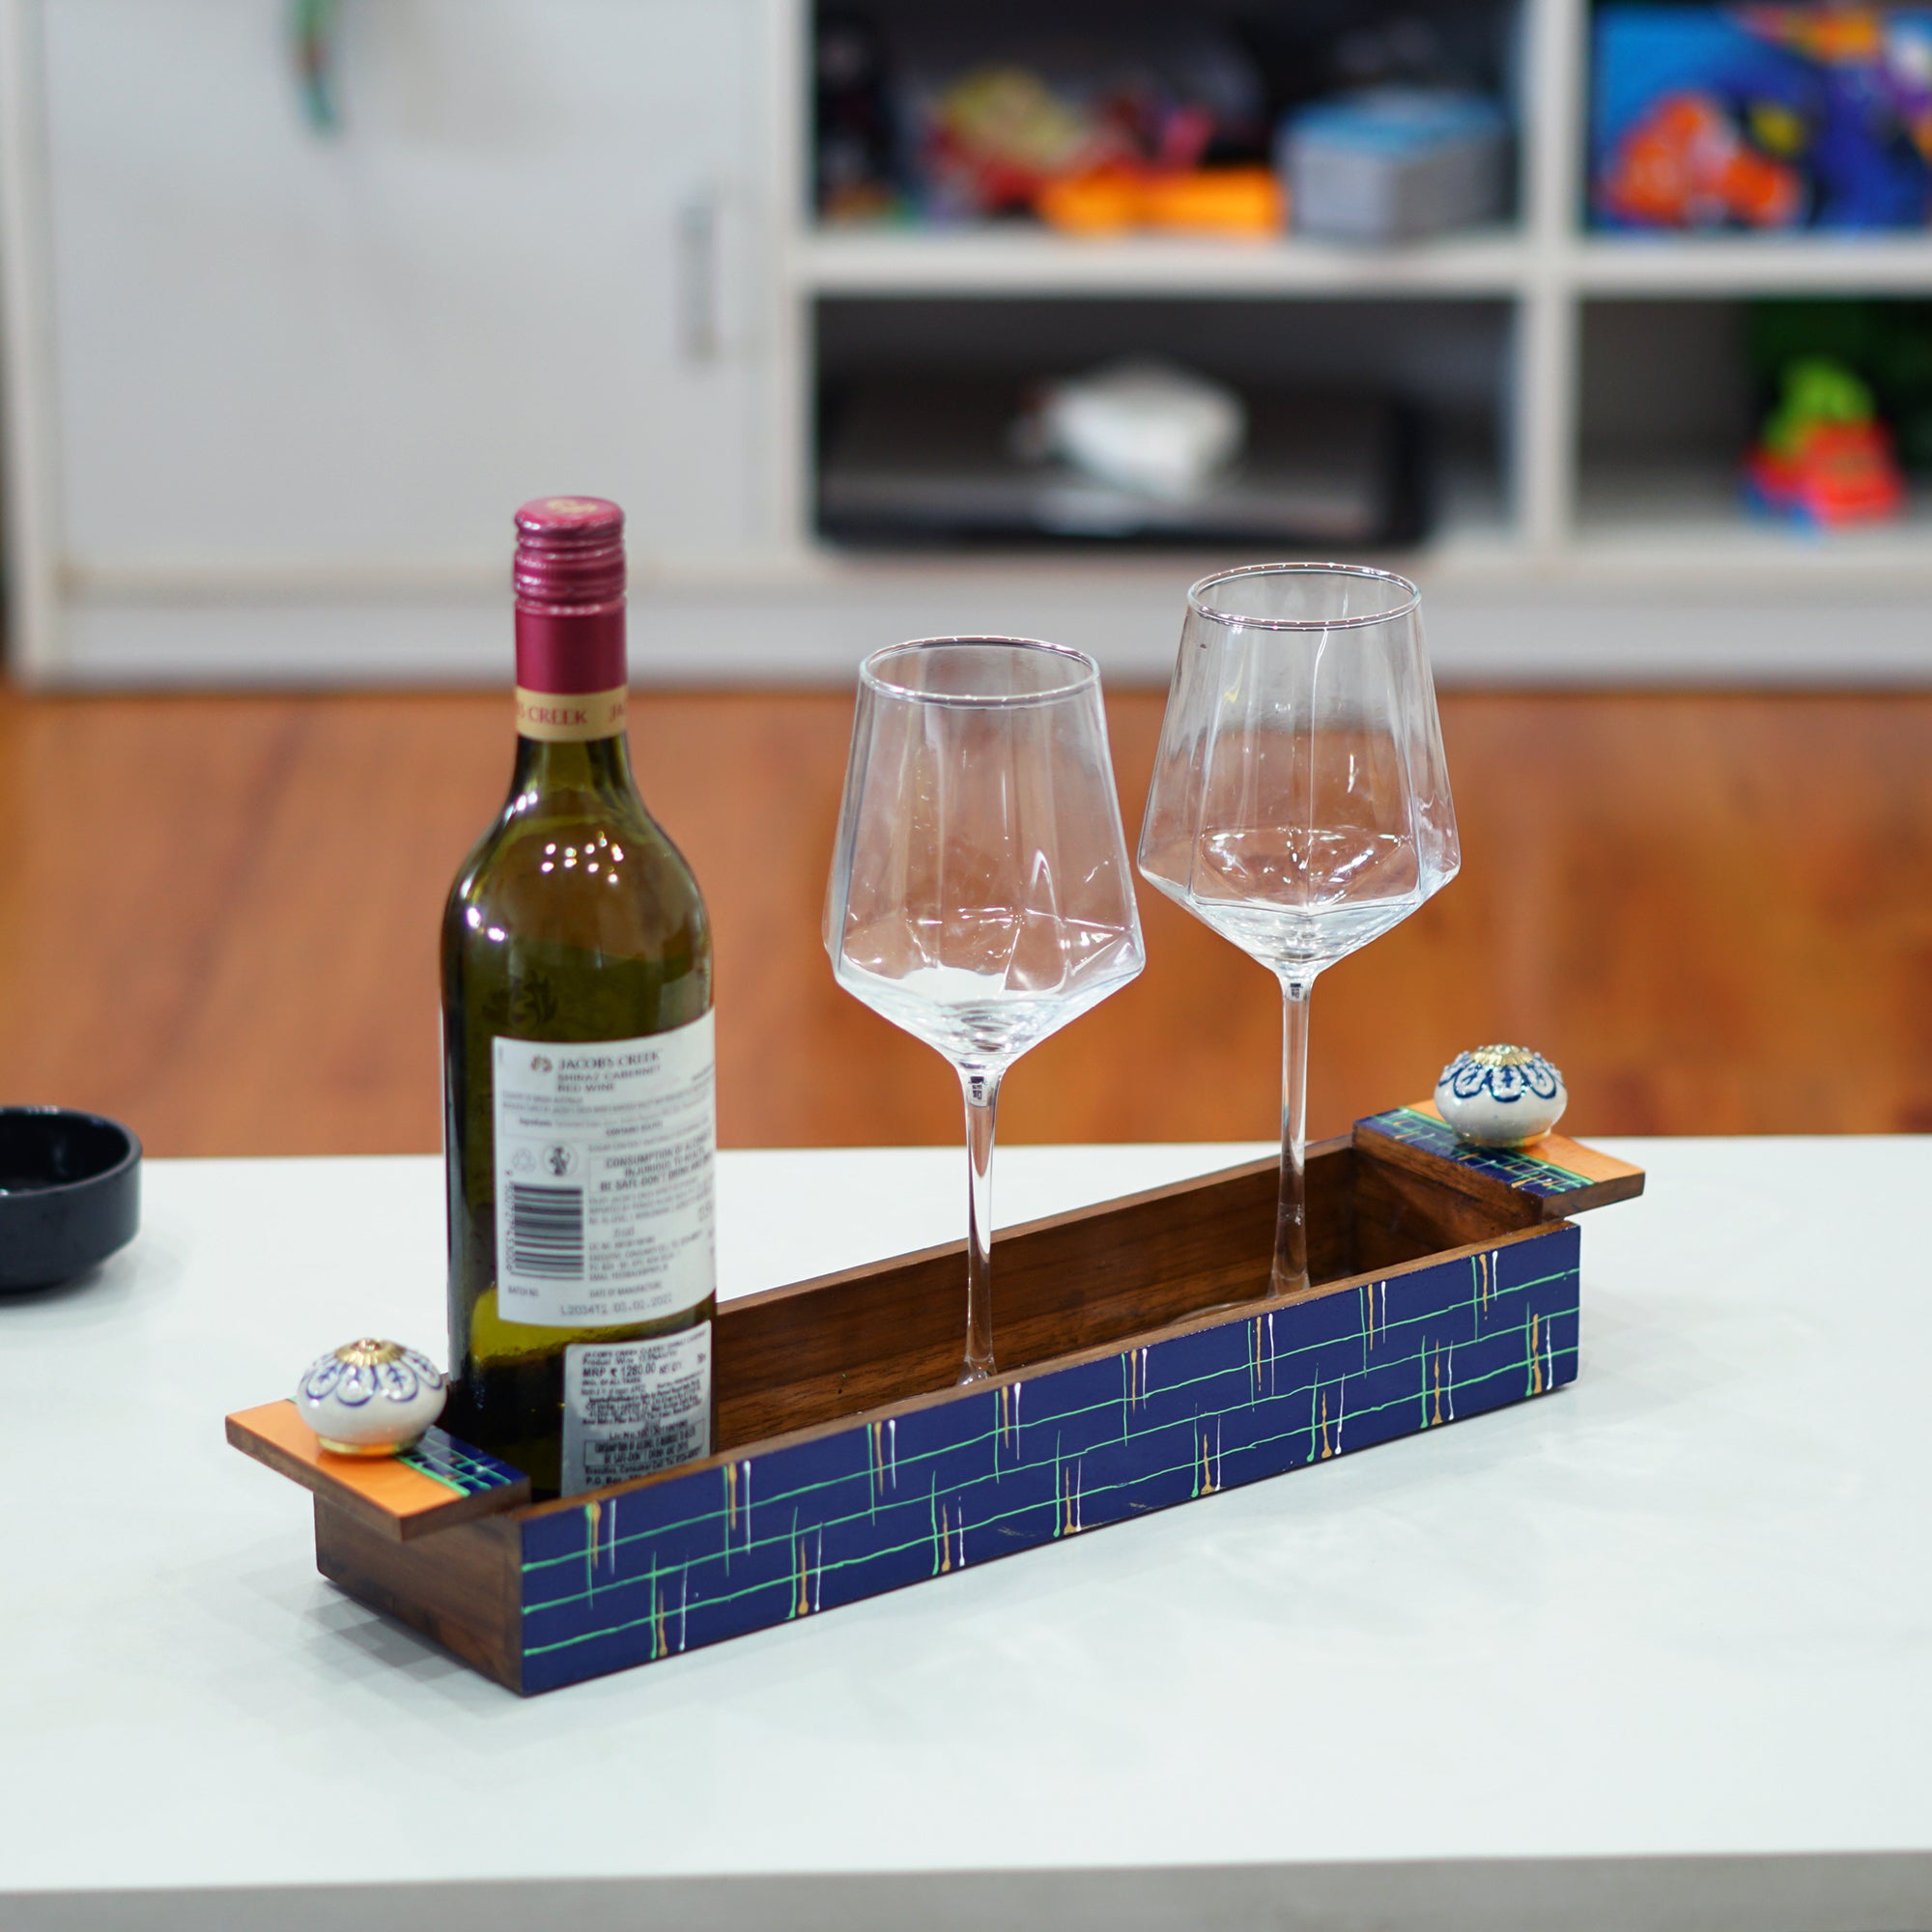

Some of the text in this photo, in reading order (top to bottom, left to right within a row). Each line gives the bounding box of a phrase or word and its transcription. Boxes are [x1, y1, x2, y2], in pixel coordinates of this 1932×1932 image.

[527, 705, 588, 726] CREEK
[617, 1051, 661, 1066] CREEK
[556, 1065, 662, 1083] SHIRAZ CABERNET
[556, 1083, 614, 1094] RED WINE
[606, 1148, 673, 1170] CONSUMPTION
[582, 1366, 607, 1378] MRP
